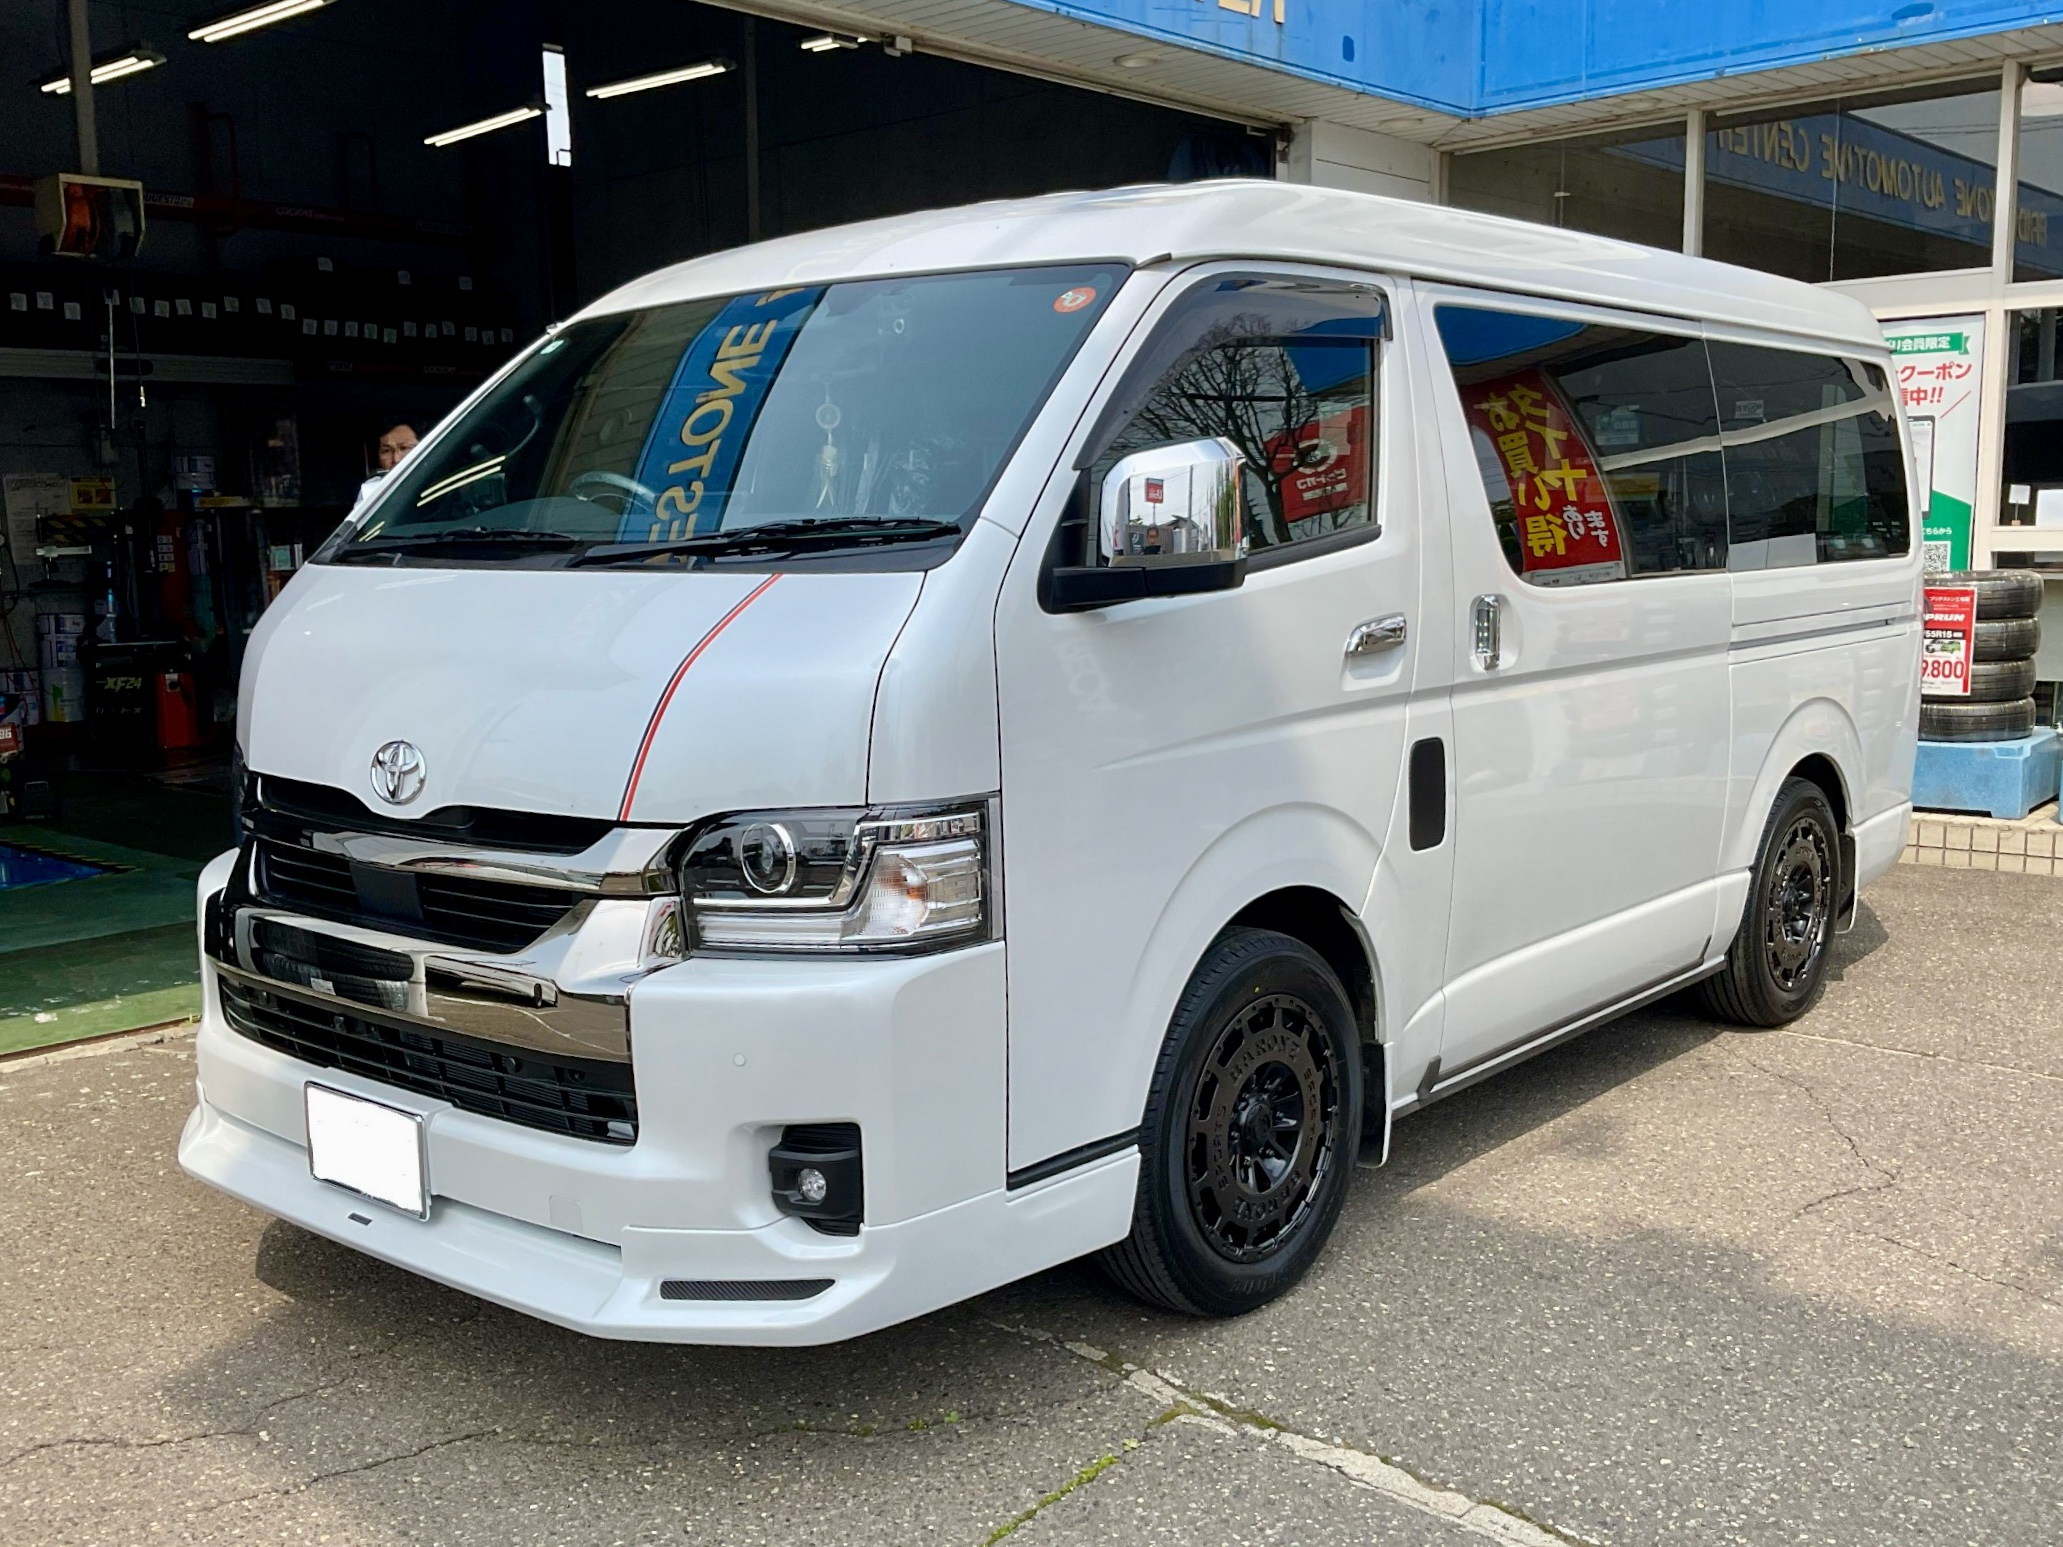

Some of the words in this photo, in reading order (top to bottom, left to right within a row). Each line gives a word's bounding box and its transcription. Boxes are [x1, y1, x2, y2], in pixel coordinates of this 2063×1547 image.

[1896, 361, 1972, 383] クーポン
[1923, 613, 1966, 622] PRUN
[1923, 629, 1953, 638] 55R15
